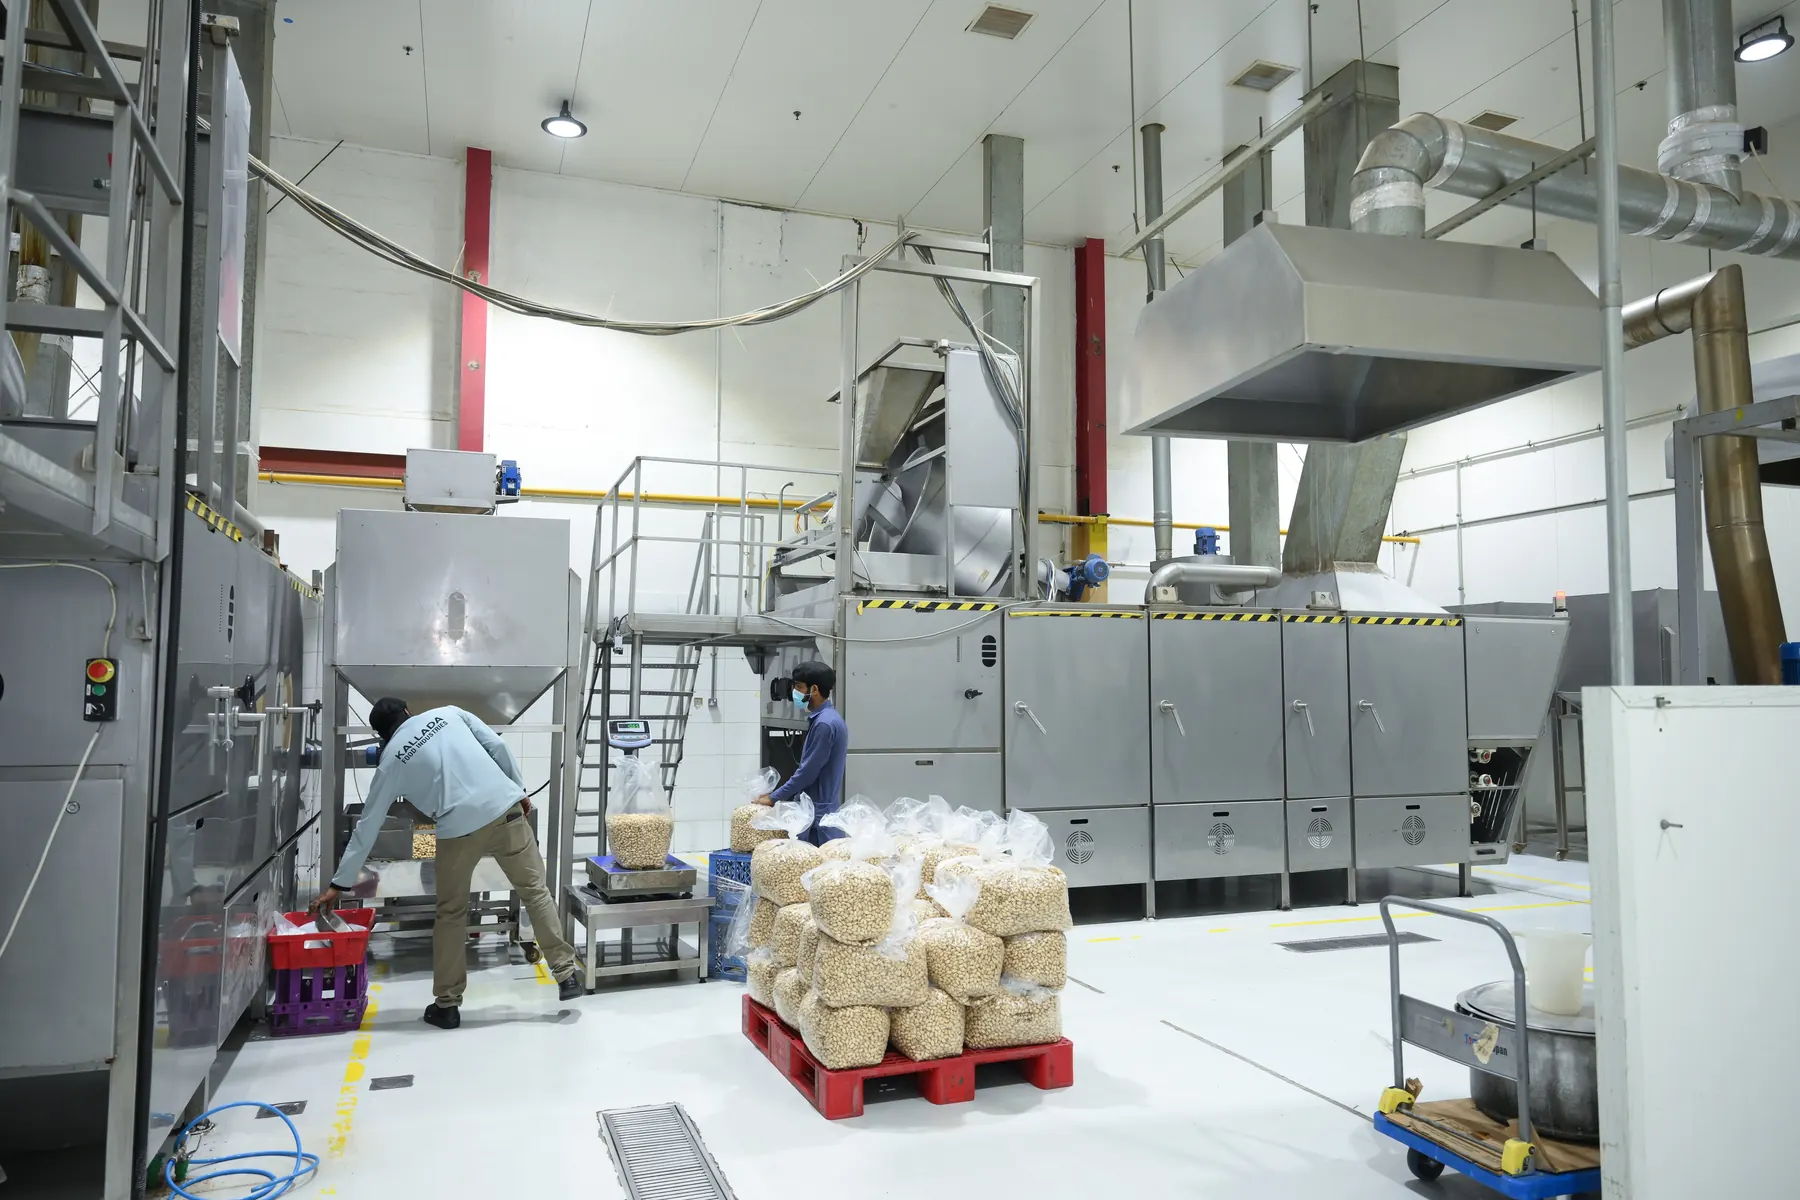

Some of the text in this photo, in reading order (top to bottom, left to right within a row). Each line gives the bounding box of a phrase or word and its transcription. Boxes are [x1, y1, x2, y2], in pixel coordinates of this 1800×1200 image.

[395, 717, 443, 760] KALLADA
[401, 721, 448, 764] FOOD INDUSTRIES
[1492, 1045, 1508, 1056] pan
